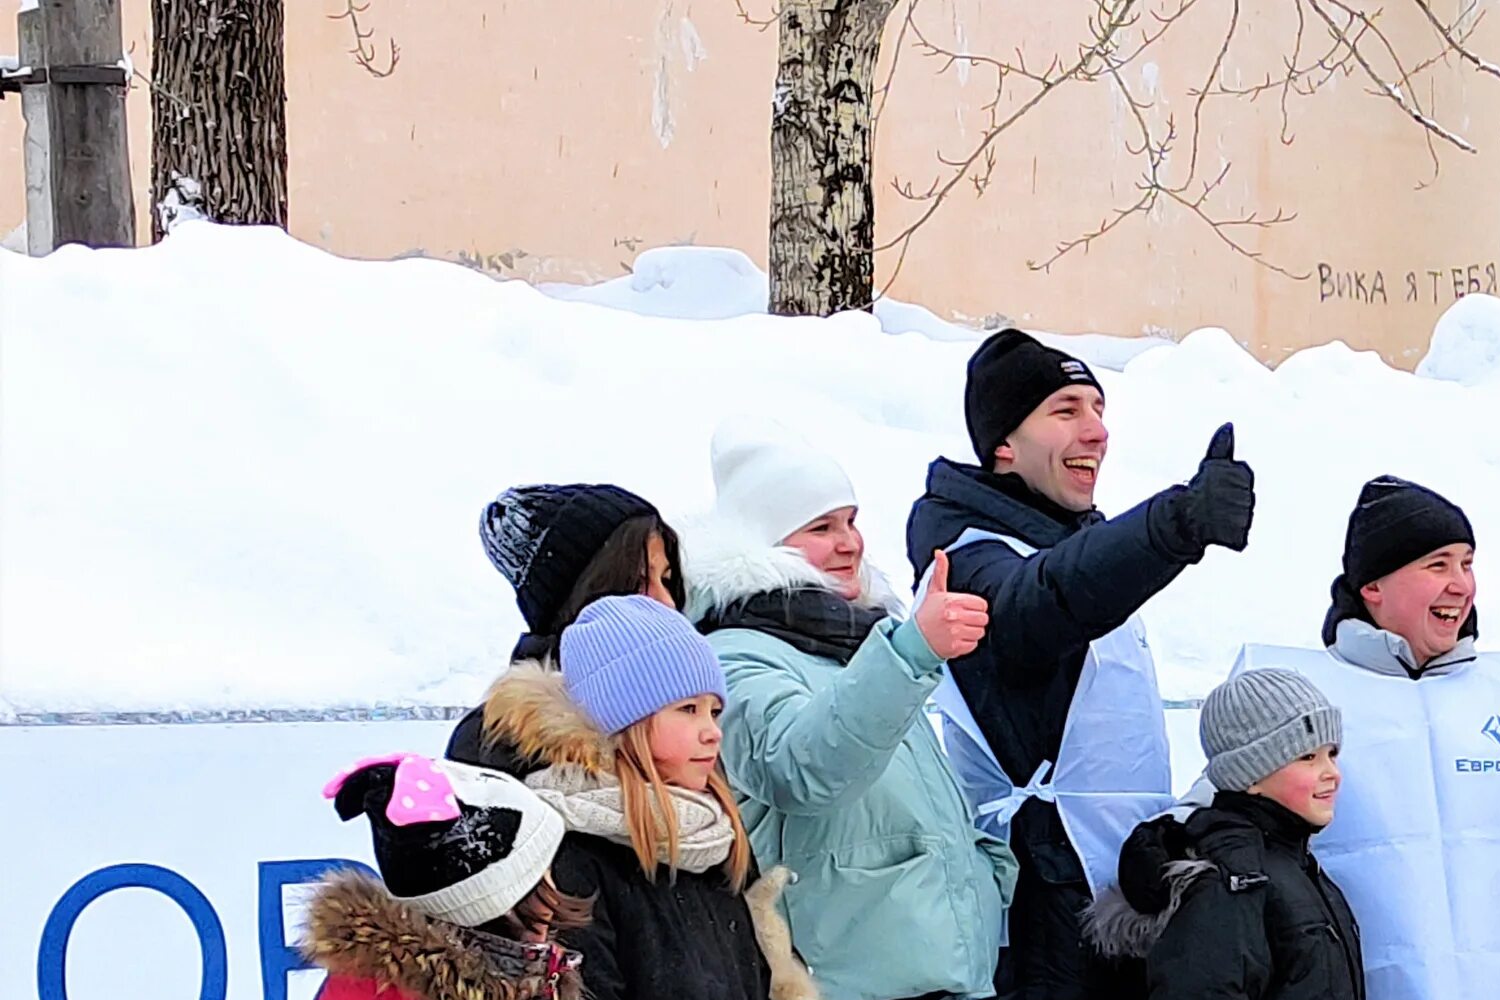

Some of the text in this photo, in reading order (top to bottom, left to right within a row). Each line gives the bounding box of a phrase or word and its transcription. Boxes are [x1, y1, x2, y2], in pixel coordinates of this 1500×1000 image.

[1317, 261, 1498, 305] ВИКА Я ТЕБЯ
